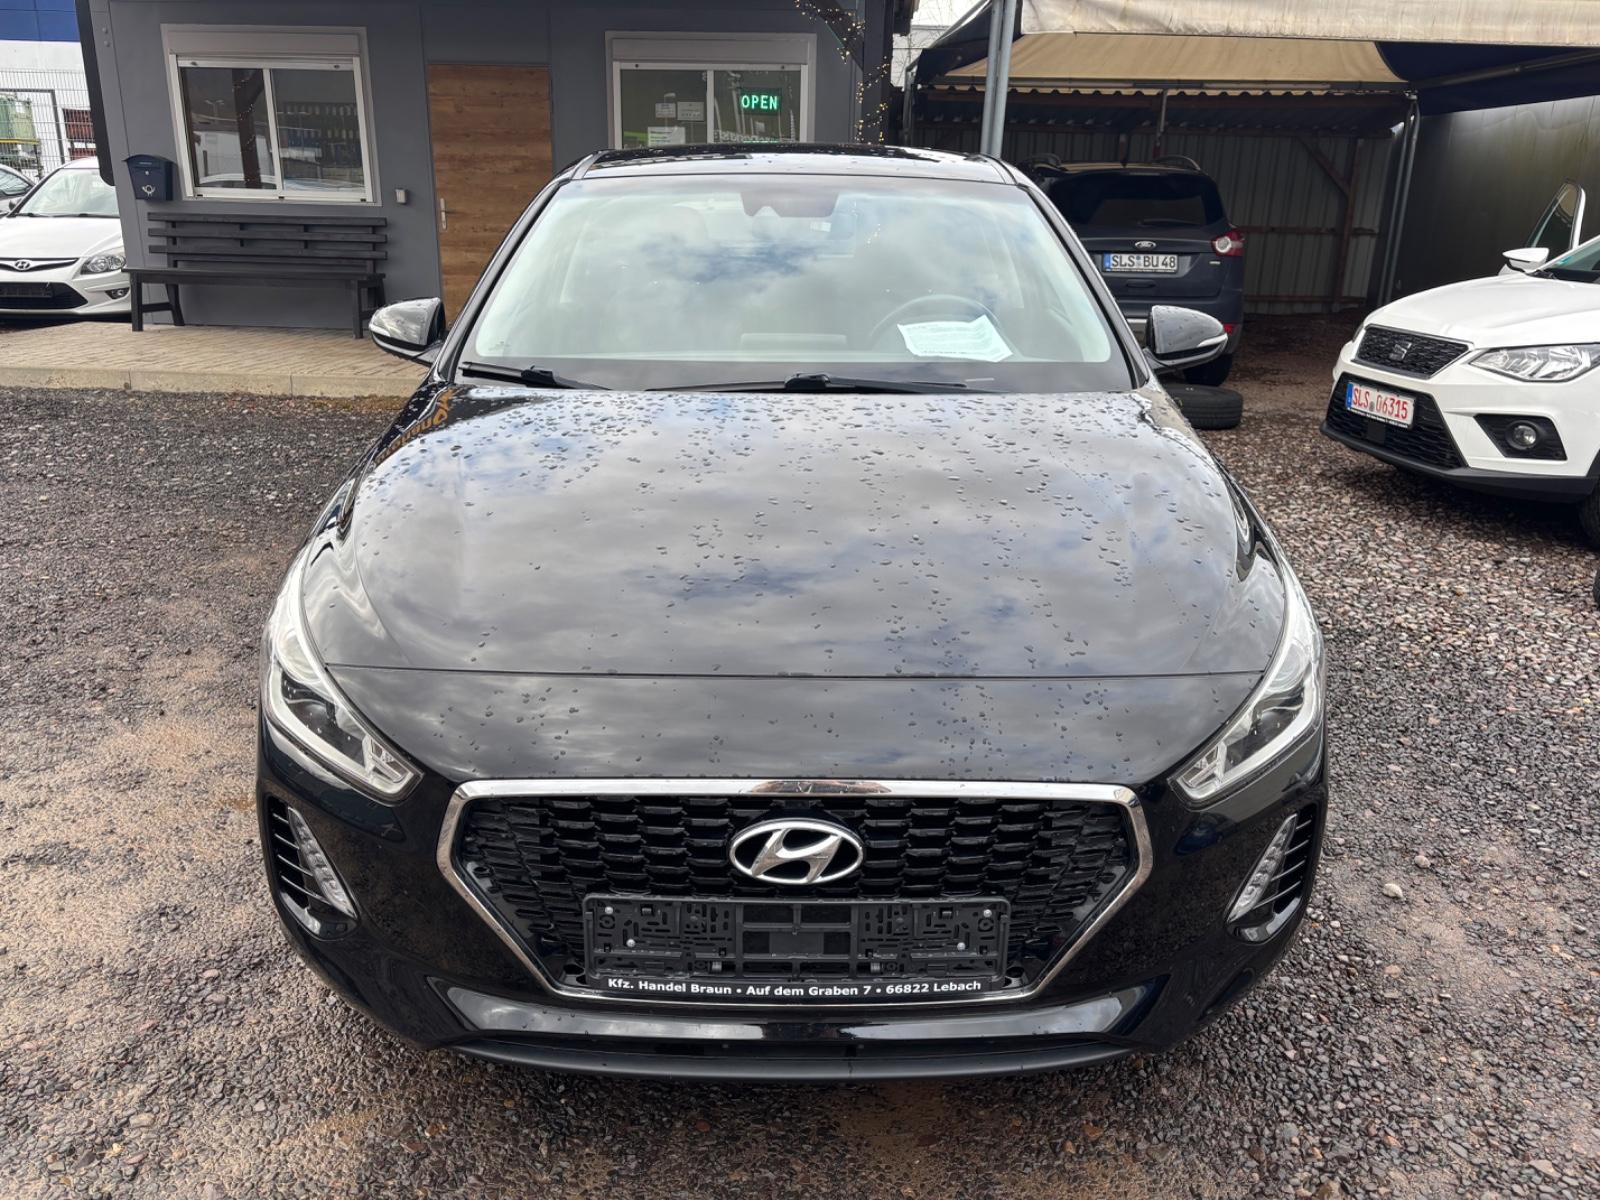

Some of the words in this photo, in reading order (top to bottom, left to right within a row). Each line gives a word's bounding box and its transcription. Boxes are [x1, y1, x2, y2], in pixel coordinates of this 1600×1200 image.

[741, 94, 778, 110] OPEN
[1112, 255, 1135, 268] SLS
[1353, 388, 1370, 408] SLS
[1376, 395, 1408, 420] 06315
[608, 978, 634, 989] Kfz.
[638, 980, 687, 992] Handel
[691, 983, 732, 995] Braun
[746, 985, 770, 996] Auf
[774, 985, 804, 996] dem
[808, 985, 858, 996] Graben
[863, 985, 872, 995] 7
[886, 983, 929, 995] 66822
[933, 980, 981, 992] Lebach
